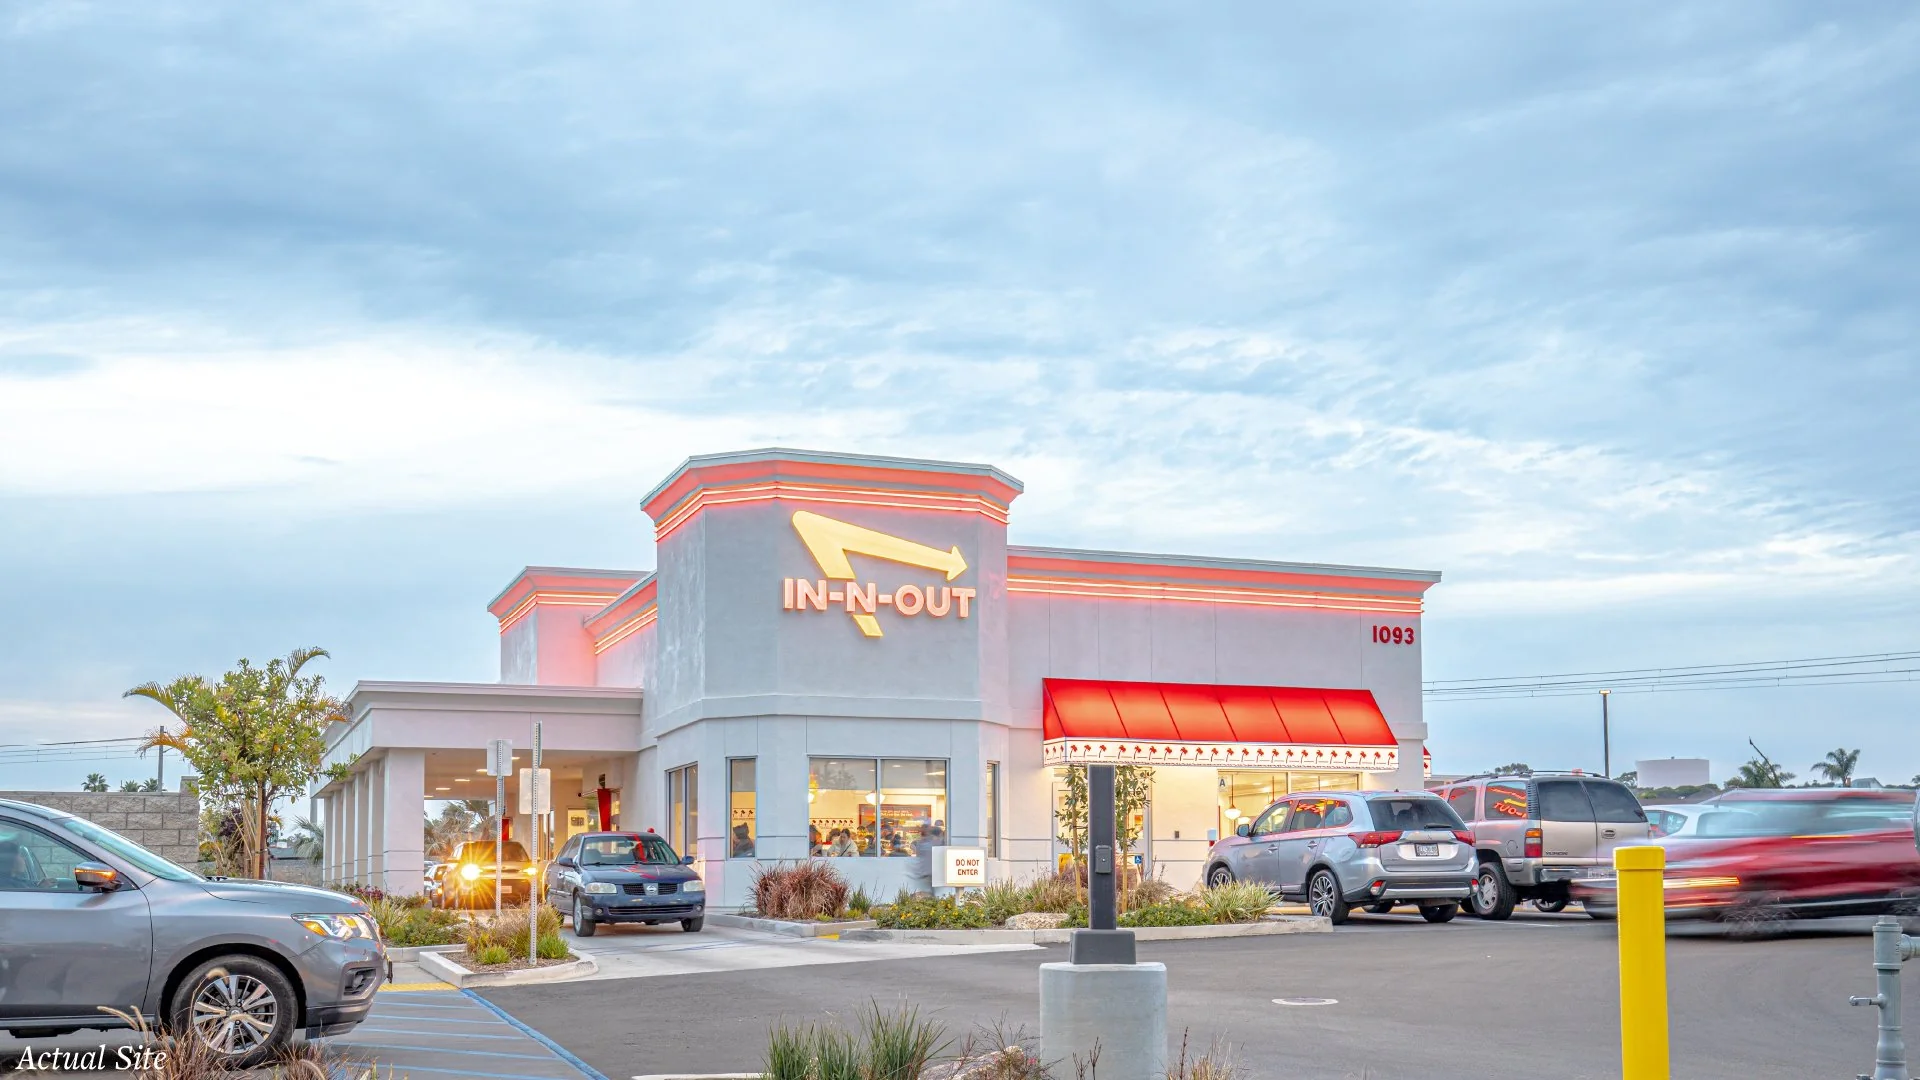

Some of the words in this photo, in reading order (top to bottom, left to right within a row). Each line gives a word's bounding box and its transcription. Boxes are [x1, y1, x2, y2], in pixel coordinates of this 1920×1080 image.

[783, 577, 976, 618] IN-N-OUT
[1372, 624, 1415, 645] 1093
[1219, 778, 1226, 787] A
[955, 859, 966, 867] DO
[966, 859, 980, 867] NOT
[957, 868, 979, 876] ENTER
